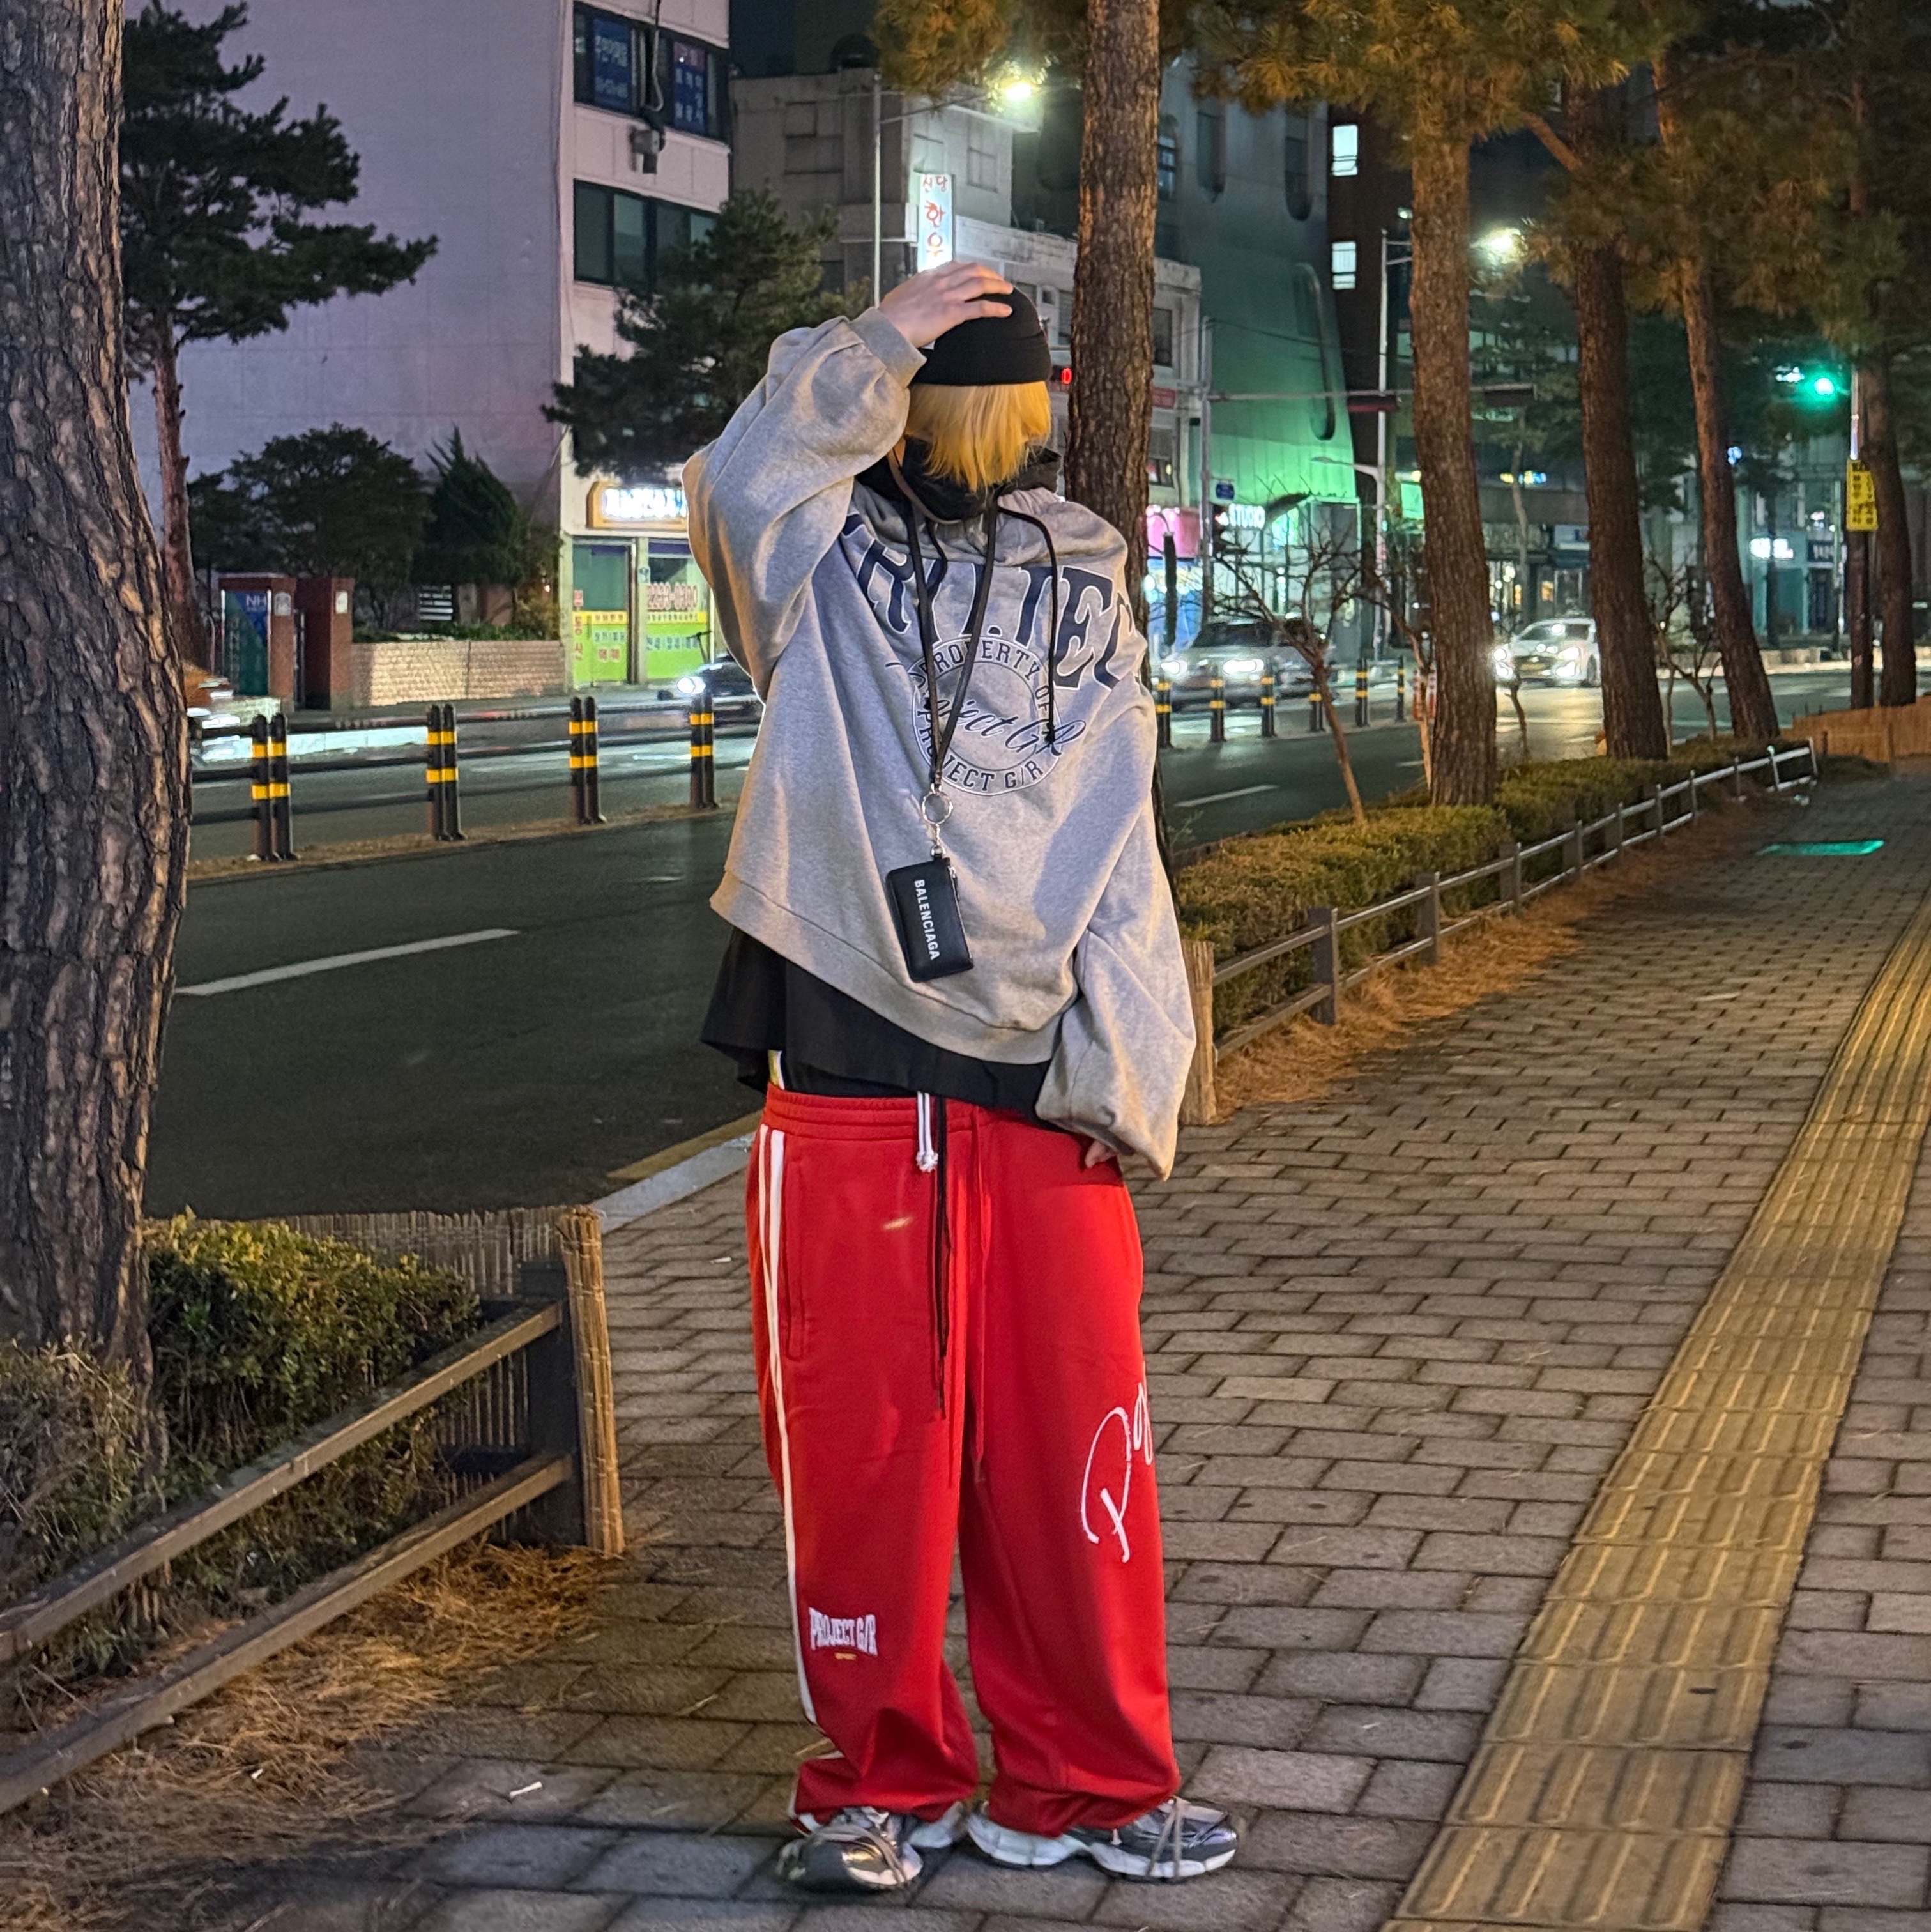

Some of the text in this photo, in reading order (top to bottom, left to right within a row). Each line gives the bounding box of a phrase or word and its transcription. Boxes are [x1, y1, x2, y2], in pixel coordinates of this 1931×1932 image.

[924, 199, 947, 257] 한우
[245, 594, 266, 607] NH
[1004, 760, 1044, 789] G/R
[914, 878, 940, 961] BALENCIAGA
[807, 1606, 856, 1651] PROJECT
